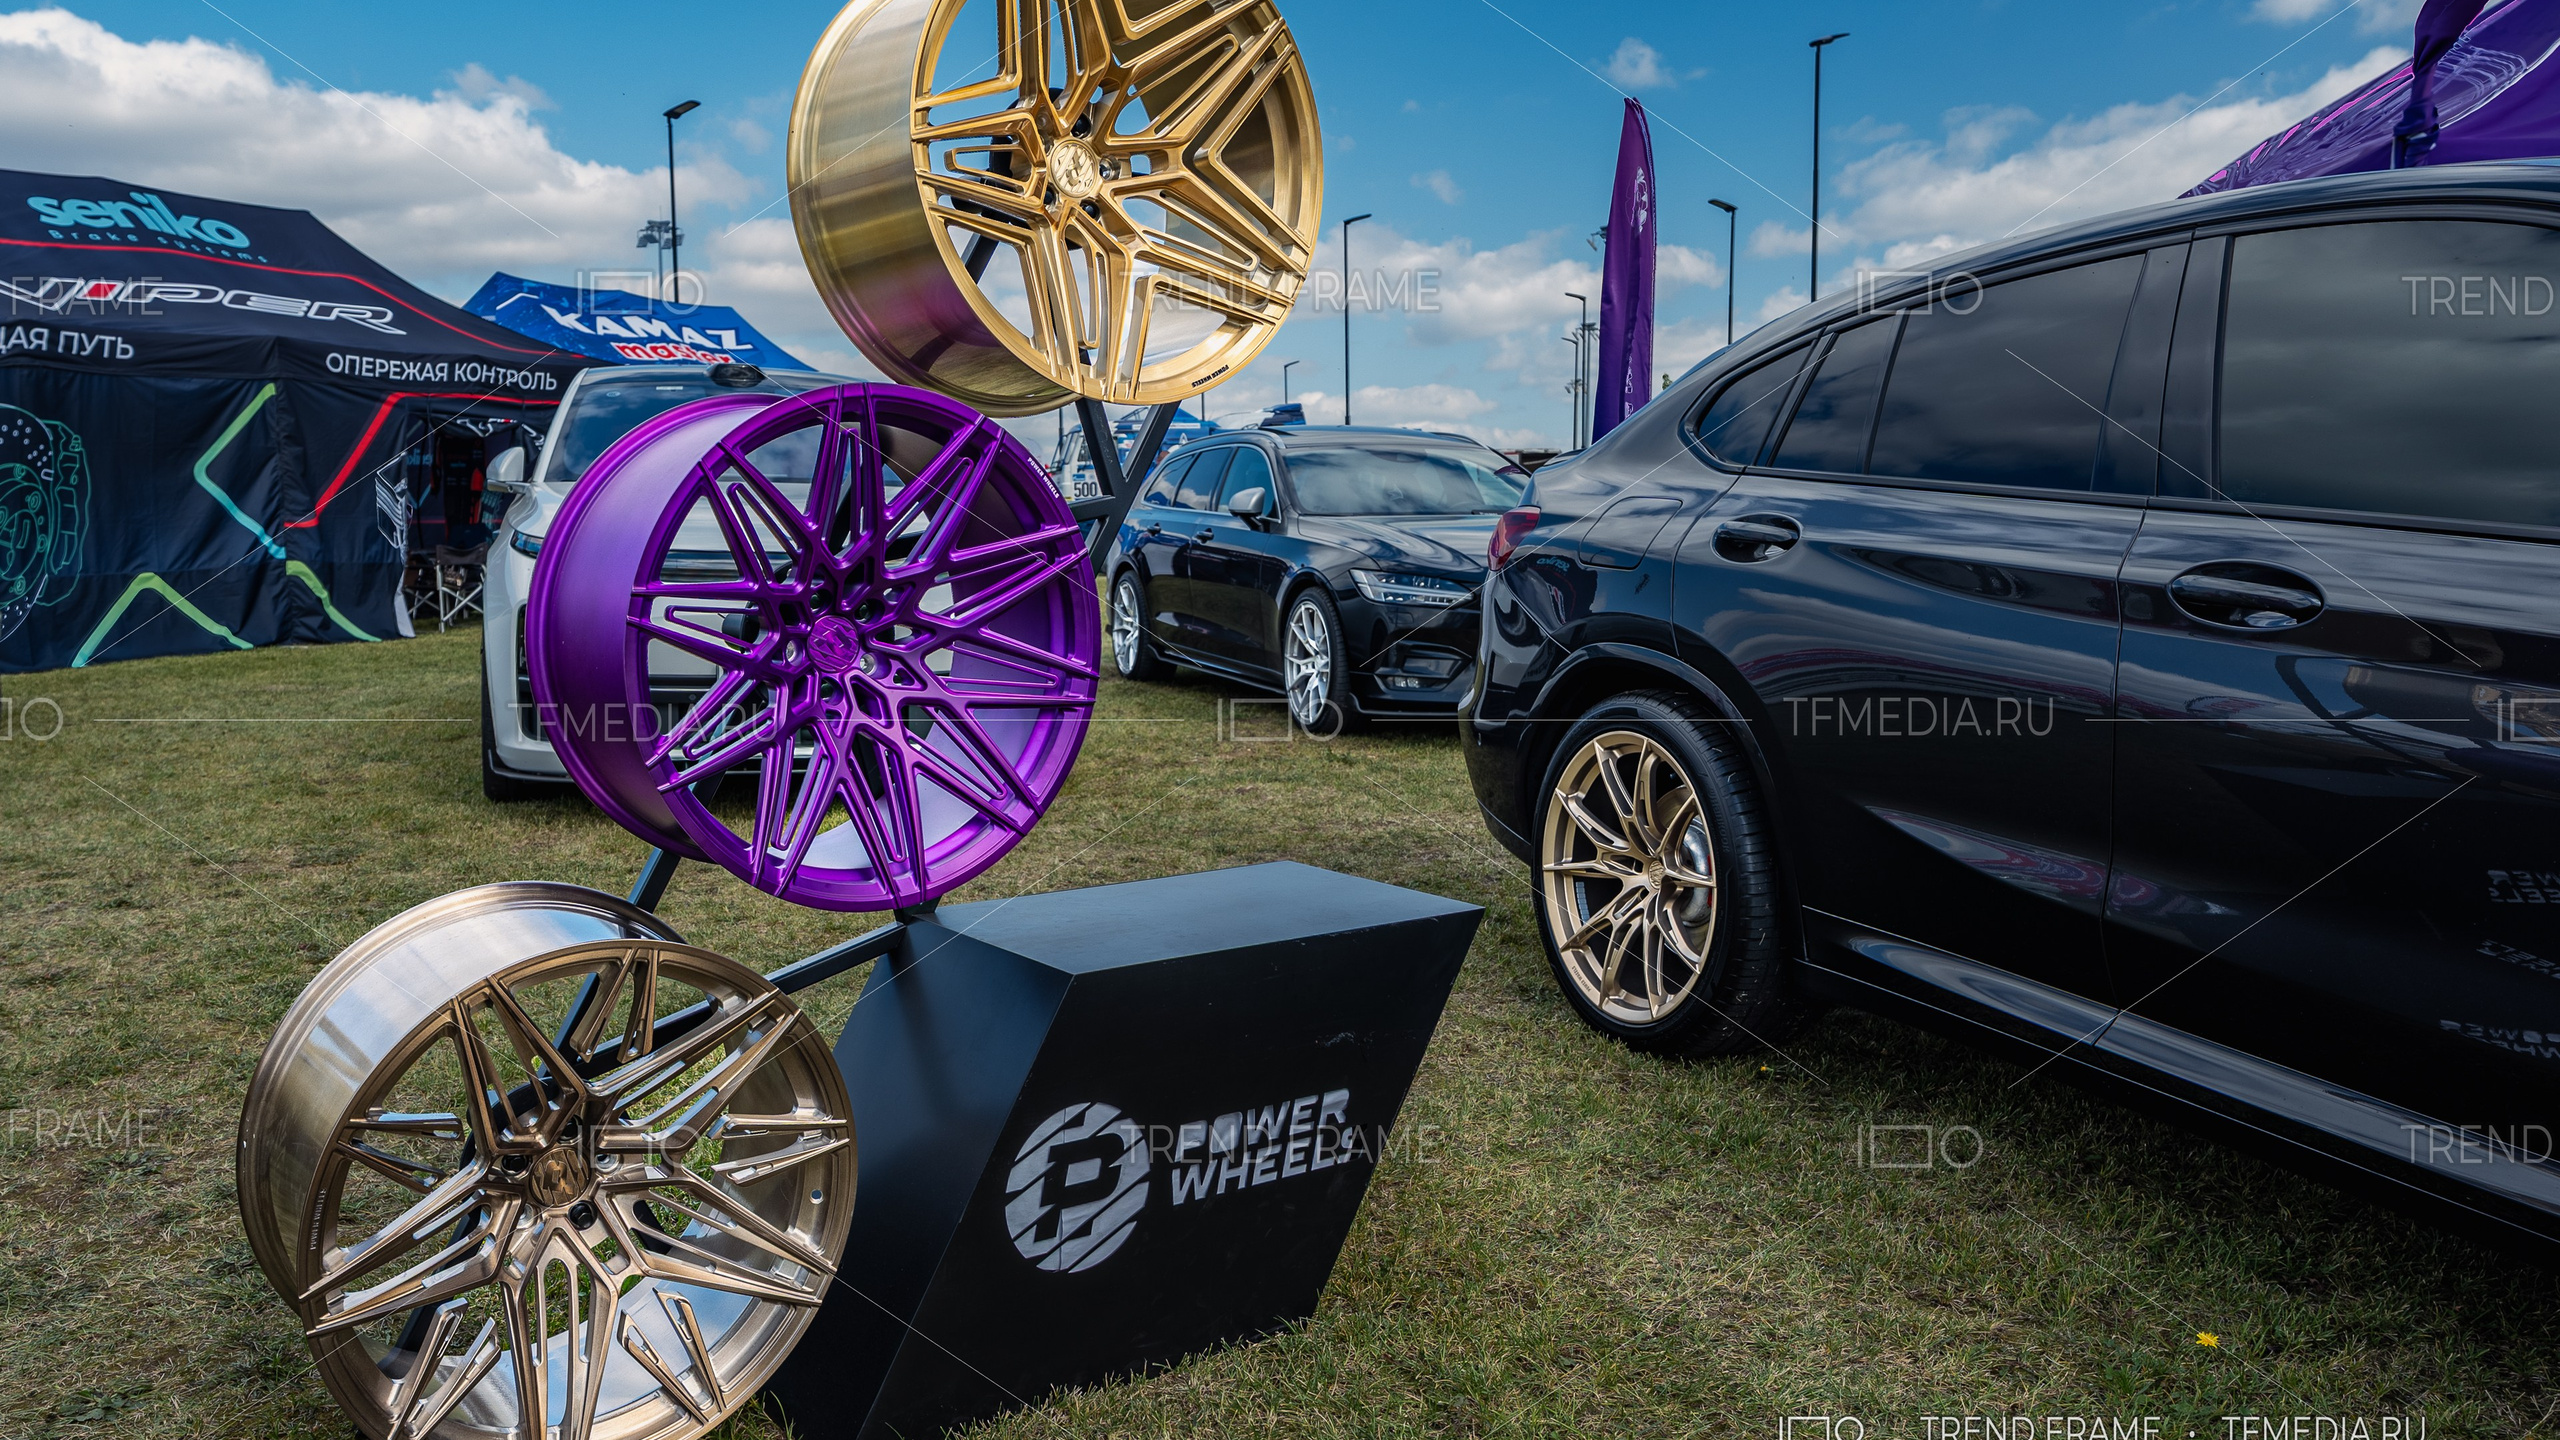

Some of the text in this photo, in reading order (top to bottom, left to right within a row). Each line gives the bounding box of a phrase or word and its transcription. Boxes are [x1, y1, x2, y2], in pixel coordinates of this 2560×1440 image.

[27, 191, 250, 249] seniko
[48, 229, 268, 264] Brake systems
[57, 329, 135, 360] ПУТЬ
[540, 303, 754, 350] KAMAZ
[325, 352, 557, 391] ОПЕРЕЖАЯ КОНТРОЛЬ
[610, 341, 737, 365] master
[1027, 456, 1060, 499] POWER WHEELS
[1074, 481, 1098, 498] 500
[1173, 1087, 1351, 1162] POWER
[1171, 1123, 1360, 1207] WHEELS
